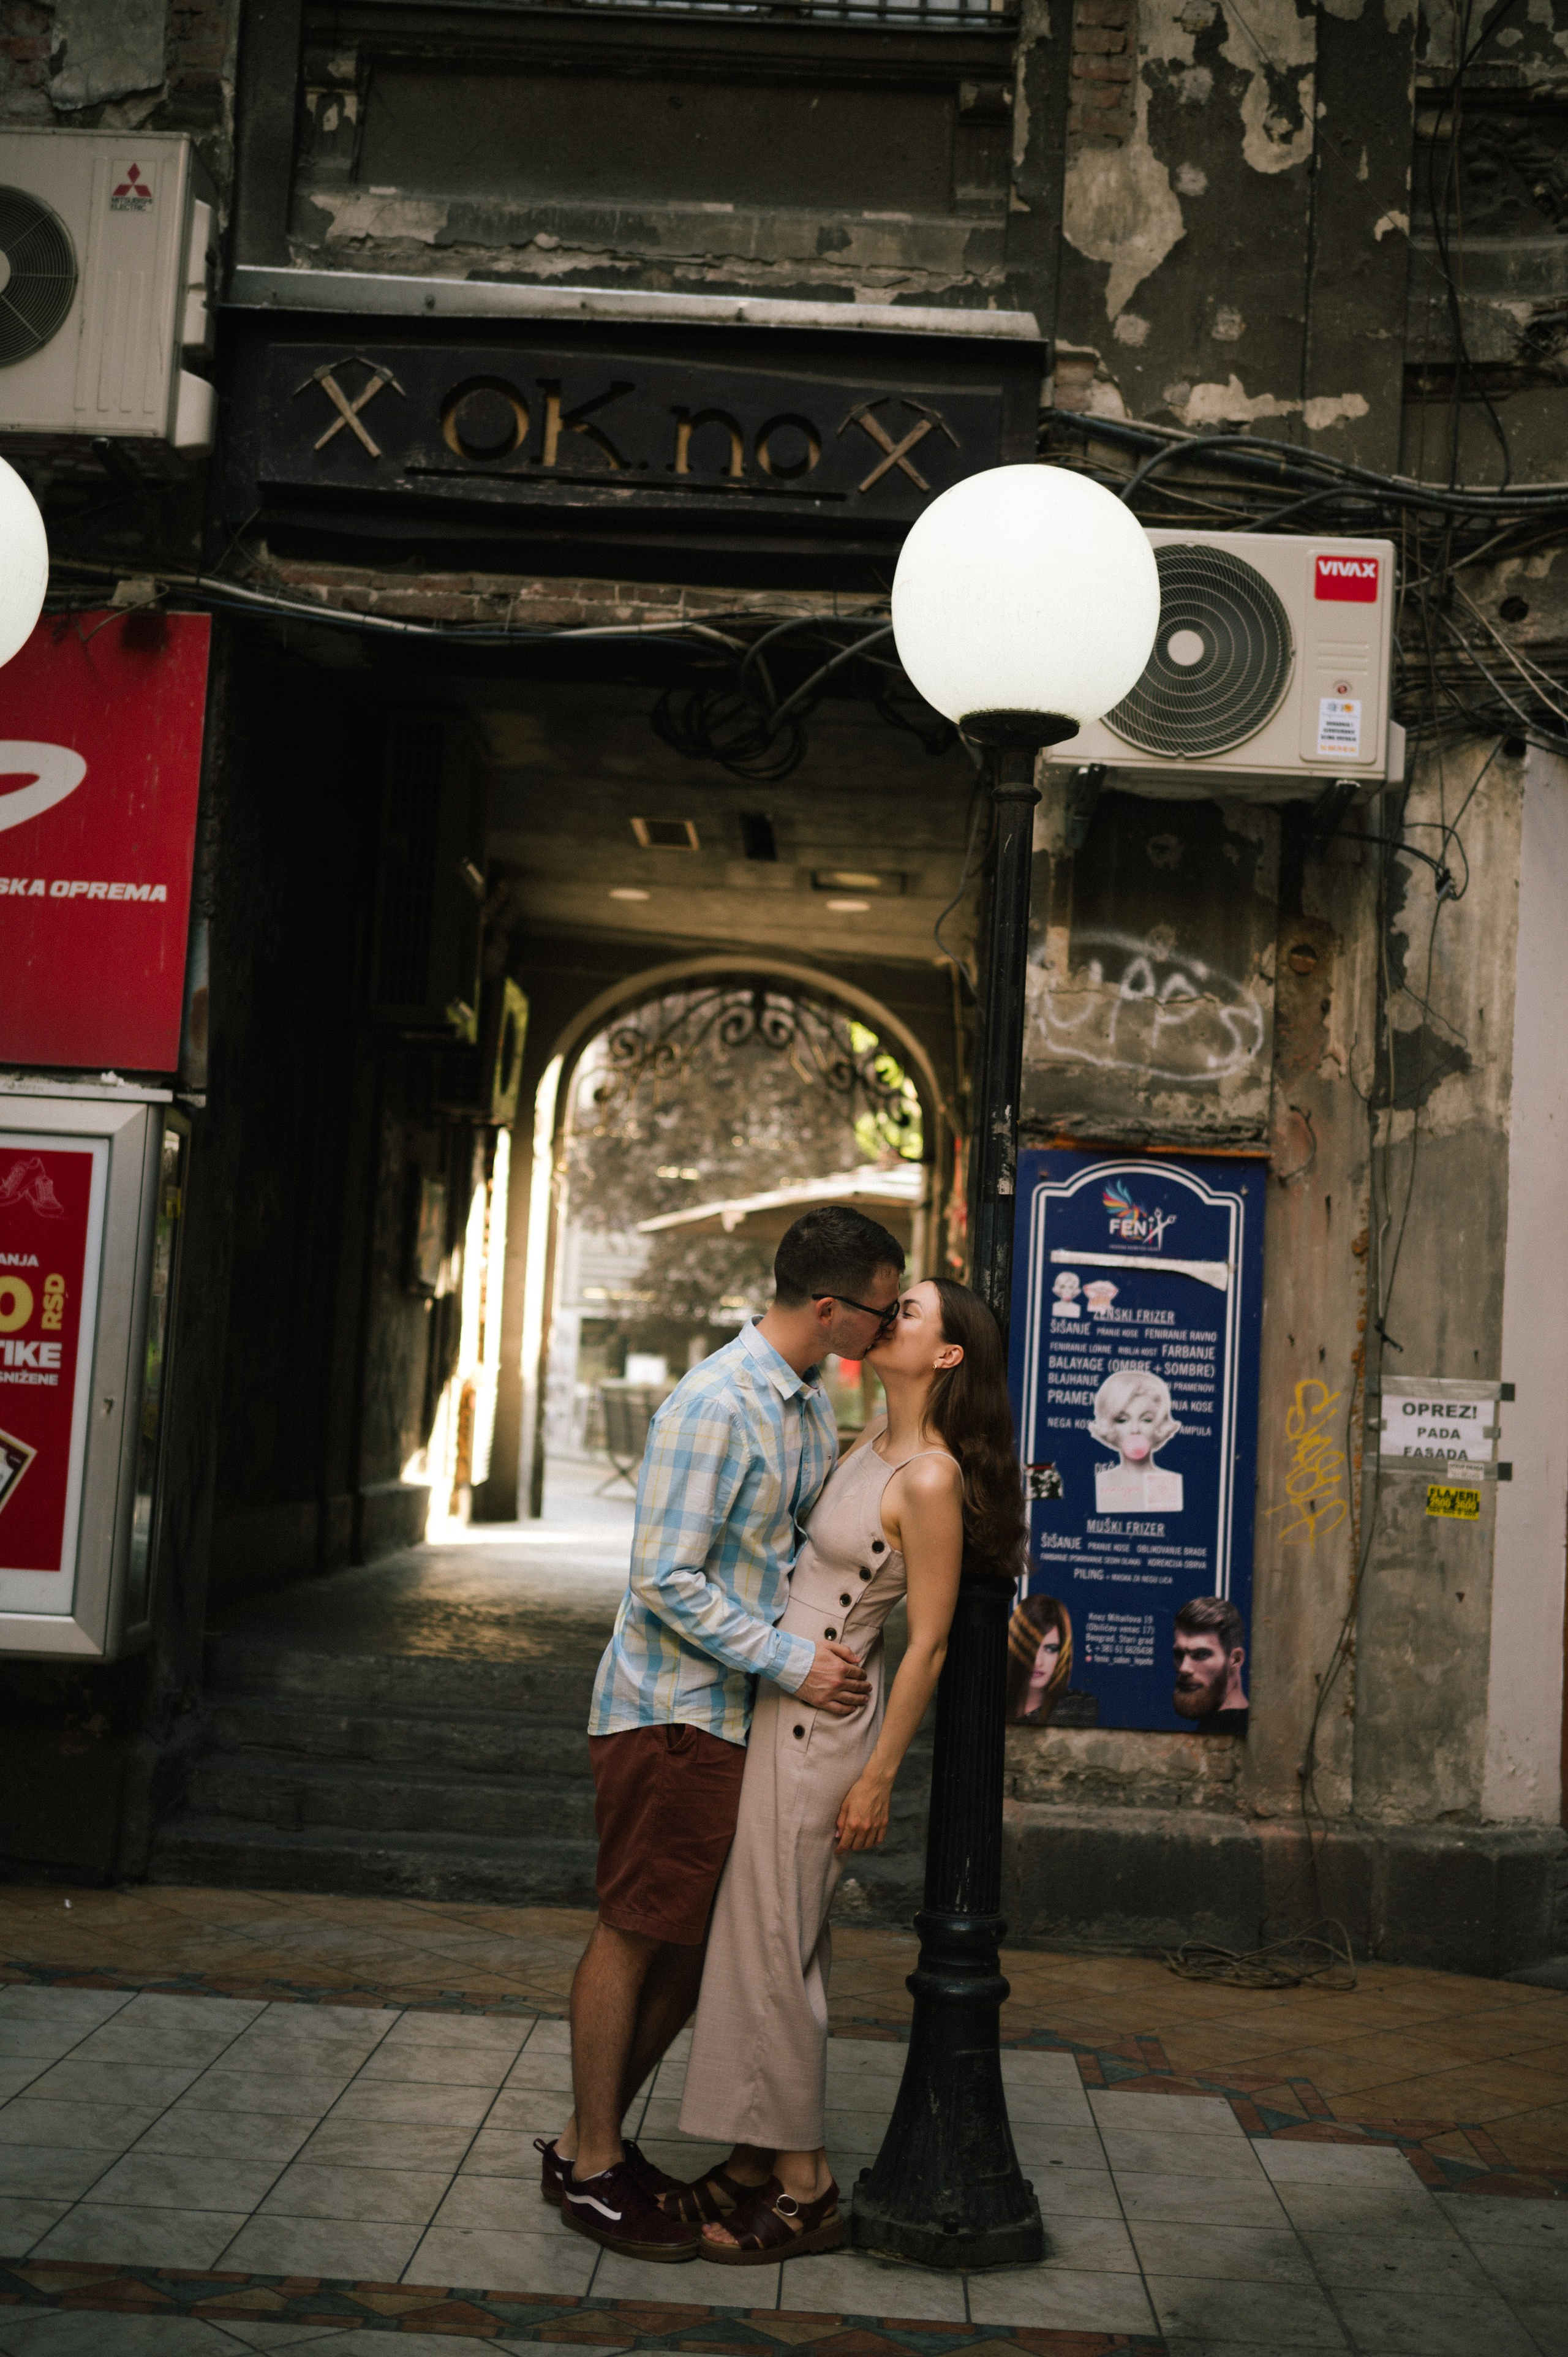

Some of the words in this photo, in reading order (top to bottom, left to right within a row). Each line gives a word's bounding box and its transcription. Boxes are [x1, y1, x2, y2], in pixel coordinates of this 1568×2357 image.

[1318, 560, 1376, 578] VIVAX
[49, 879, 167, 903] OPREMA
[41, 1273, 65, 1330] RSD
[1137, 1308, 1175, 1324] FRIZER
[1050, 1319, 1090, 1336] ŠIŠANJE
[1096, 1327, 1120, 1337] PRANJE
[1122, 1329, 1139, 1338] KOSE
[1145, 1328, 1187, 1341] FENIRANJE
[1190, 1330, 1217, 1342] RAVNO
[1050, 1341, 1087, 1352] FENIRANJE
[1089, 1343, 1112, 1354] LOKNE
[1162, 1344, 1215, 1360] FARBANJE
[1049, 1356, 1103, 1372] BALAYAGE
[1107, 1359, 1151, 1373] (OMBRE
[1153, 1363, 1163, 1375] +
[1164, 1362, 1216, 1378] SOMBRE)
[1048, 1372, 1099, 1387] BLAJHANJE
[1174, 1382, 1215, 1393] PRAMENOVI
[1191, 1401, 1214, 1413] KOSE
[1403, 1402, 1477, 1419] OPREZ!
[1047, 1417, 1072, 1428] NEGA
[1180, 1425, 1212, 1436] AMPULA
[1417, 1427, 1460, 1439] PADA
[1404, 1446, 1468, 1460] FASADA
[1087, 1517, 1123, 1533] MUŠKI
[1126, 1522, 1165, 1536] FRIZER
[1041, 1532, 1082, 1550] ŠIŠANJE
[1088, 1542, 1112, 1552] PRANJE
[1137, 1544, 1182, 1555] OBLIKOVANJE
[1184, 1547, 1207, 1557] BRADE
[1148, 1558, 1183, 1568] KOREKCIJA
[1074, 1567, 1104, 1580] PILING
[1088, 1612, 1106, 1622] Knez
[1137, 1636, 1154, 1646] grad
